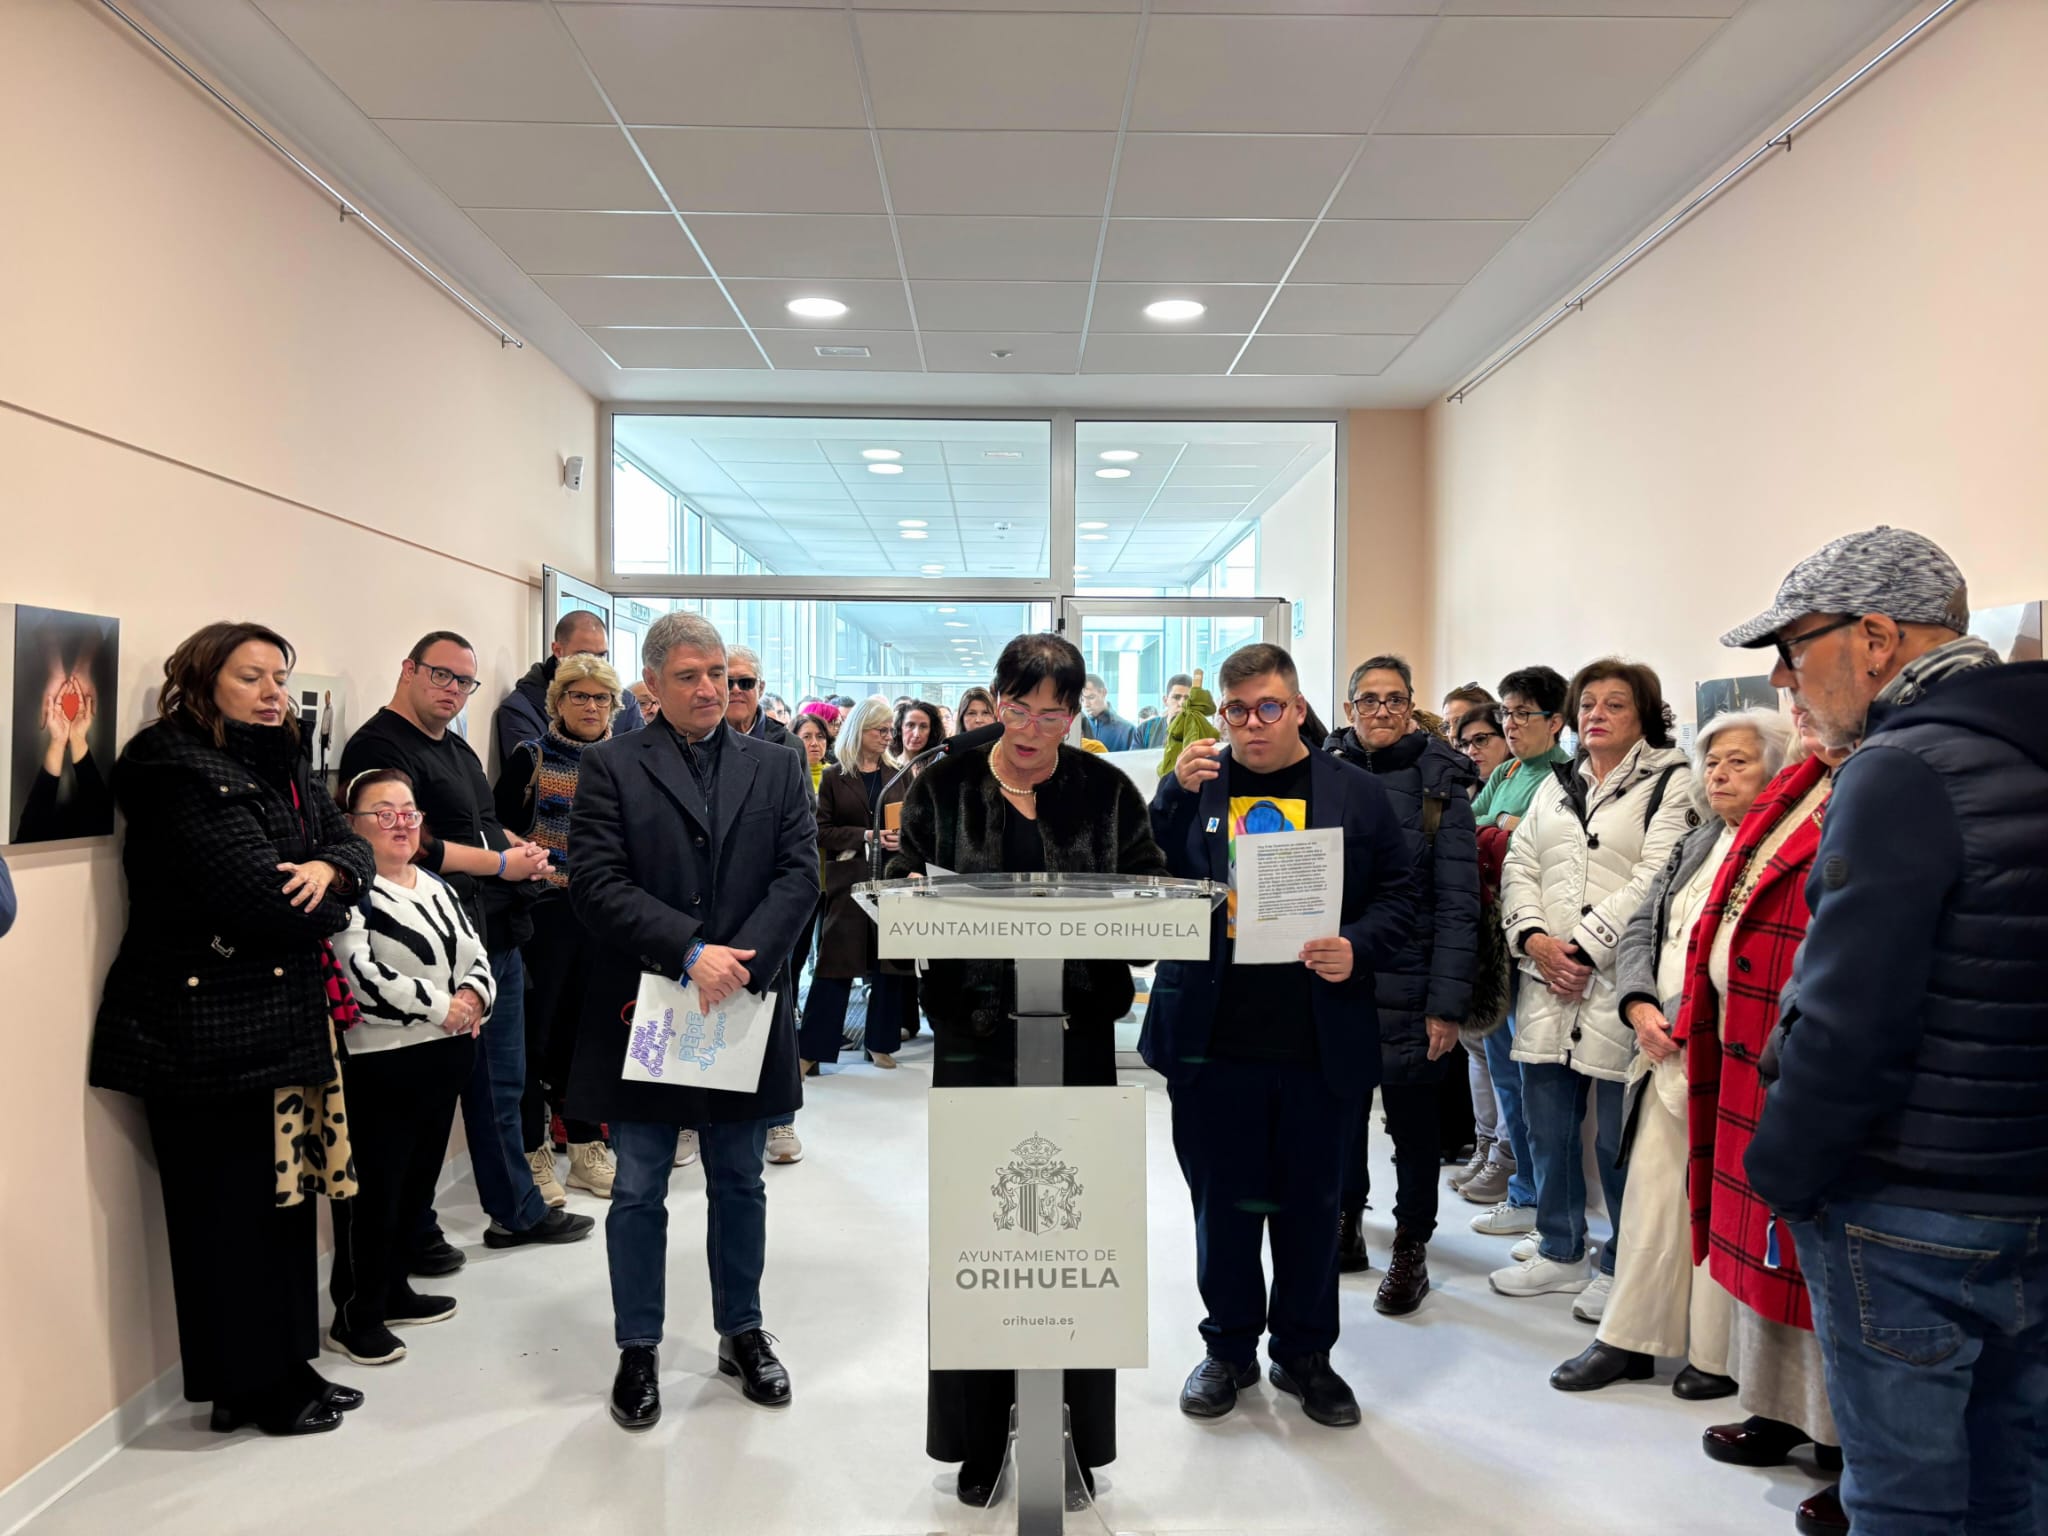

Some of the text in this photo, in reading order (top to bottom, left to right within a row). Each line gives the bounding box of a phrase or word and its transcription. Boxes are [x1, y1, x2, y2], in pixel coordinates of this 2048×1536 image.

[888, 921, 1200, 938] AYUNTAMIENTO DE ORIHUELA
[958, 1249, 1117, 1263] AYUNTAMIENTO DE
[956, 1267, 1120, 1290] ORIHUELA
[1002, 1315, 1074, 1326] orihuela.es
